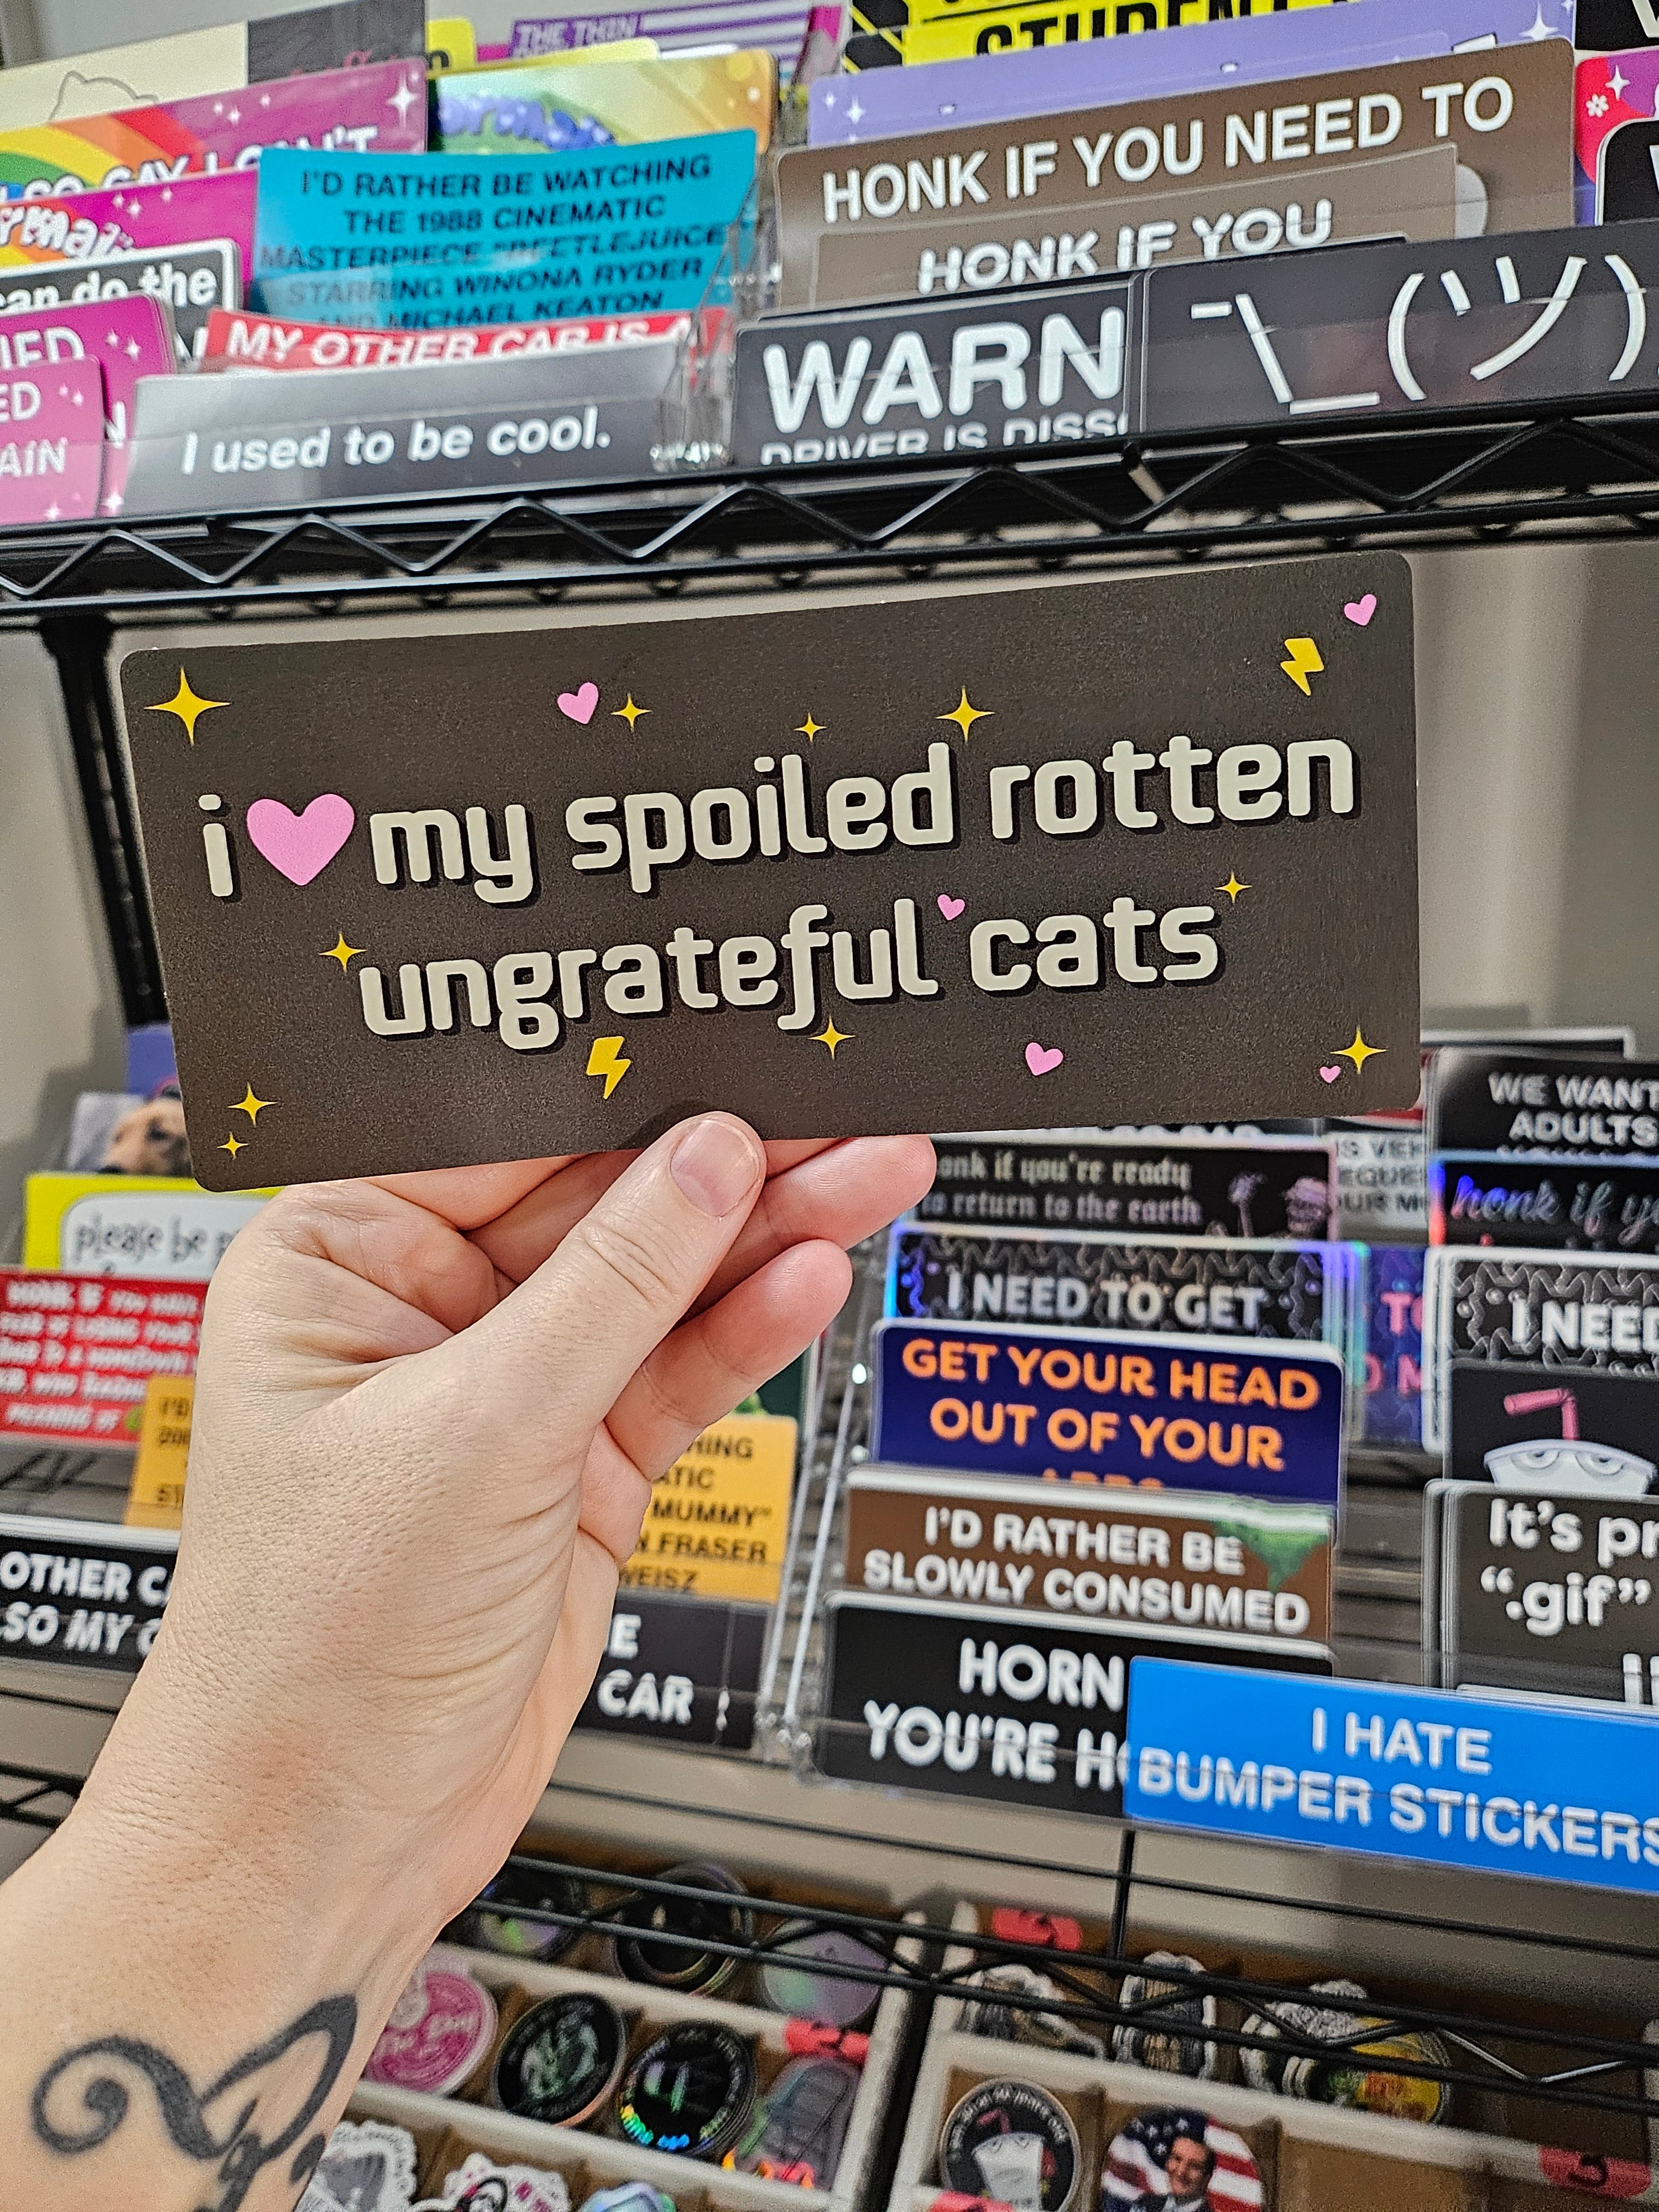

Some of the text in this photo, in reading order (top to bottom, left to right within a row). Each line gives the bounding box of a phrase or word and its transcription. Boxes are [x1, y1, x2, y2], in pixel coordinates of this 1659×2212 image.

[301, 153, 711, 198] I'D RATHER BE WATCHING
[823, 76, 1514, 222] HONK IF YOU NEED TO
[344, 208, 405, 235] THE
[493, 194, 666, 229] CINEMATIC
[918, 198, 1333, 295] HONK IF YOU
[138, 262, 217, 310] the
[455, 267, 582, 296] WINONA
[594, 257, 703, 284] RYDER
[534, 292, 663, 320] KEATON
[226, 321, 304, 363] MY
[311, 332, 480, 369] OTHER
[763, 306, 1126, 434] WARN
[181, 405, 612, 475] I used to be cool.
[198, 735, 1354, 904] i my spoiled rotten
[359, 896, 1219, 1050] ungrateful cats
[1488, 1071, 1659, 1112] WE WANT
[1508, 1108, 1659, 1149] ADULTS
[1044, 1192, 1071, 1220] to
[1076, 1189, 1122, 1222] the
[947, 1270, 1267, 1328] I NEED TO GET
[1511, 1300, 1531, 1344] I
[901, 1337, 999, 1384] GET
[1008, 1345, 1157, 1398] YOUR
[1170, 1358, 1321, 1412] HEAD
[930, 1396, 1286, 1473] OUT OF YOUR
[659, 1531, 769, 1566] FRASER
[925, 1505, 1246, 1577] I'D RATHER BE
[1490, 1498, 1584, 1553] It's
[0, 1551, 174, 1608] OTHER C
[863, 1548, 1311, 1636] SLOWLY CONSUMED
[62, 1609, 135, 1655] MY
[597, 1668, 695, 1725] CAR
[959, 1637, 1125, 1713] HORN
[863, 1699, 1060, 1784] YOU'RE
[1312, 1707, 1492, 1775] I HATE
[1138, 1746, 1372, 1828] BUMPER
